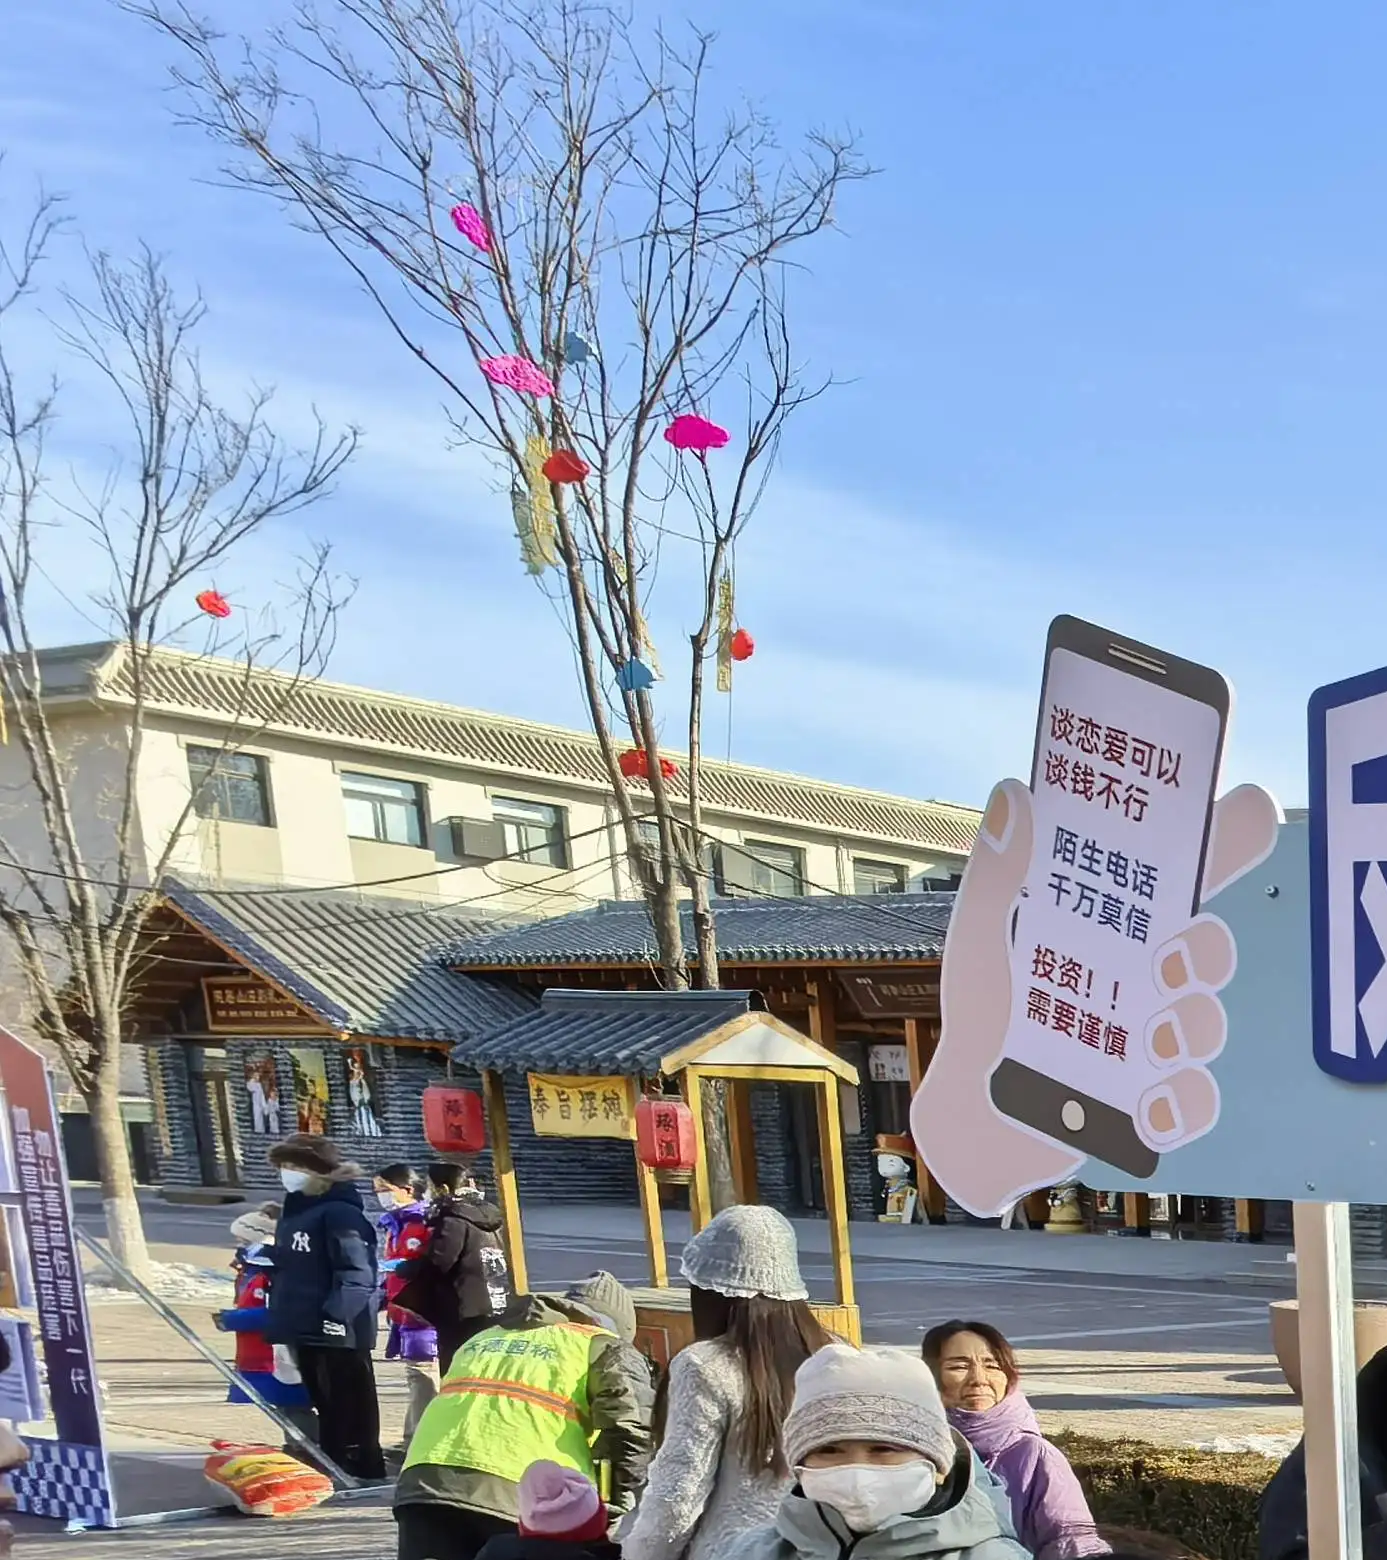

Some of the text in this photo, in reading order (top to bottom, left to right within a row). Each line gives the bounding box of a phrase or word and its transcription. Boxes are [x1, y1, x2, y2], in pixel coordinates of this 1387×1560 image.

[1049, 705, 1180, 788] 谈恋爱可以
[1044, 750, 1150, 823] 谈钱不行
[1052, 826, 1159, 901] 陌生电话
[1047, 872, 1152, 944] 千万莫信
[1027, 986, 1129, 1063] 需要谨慎
